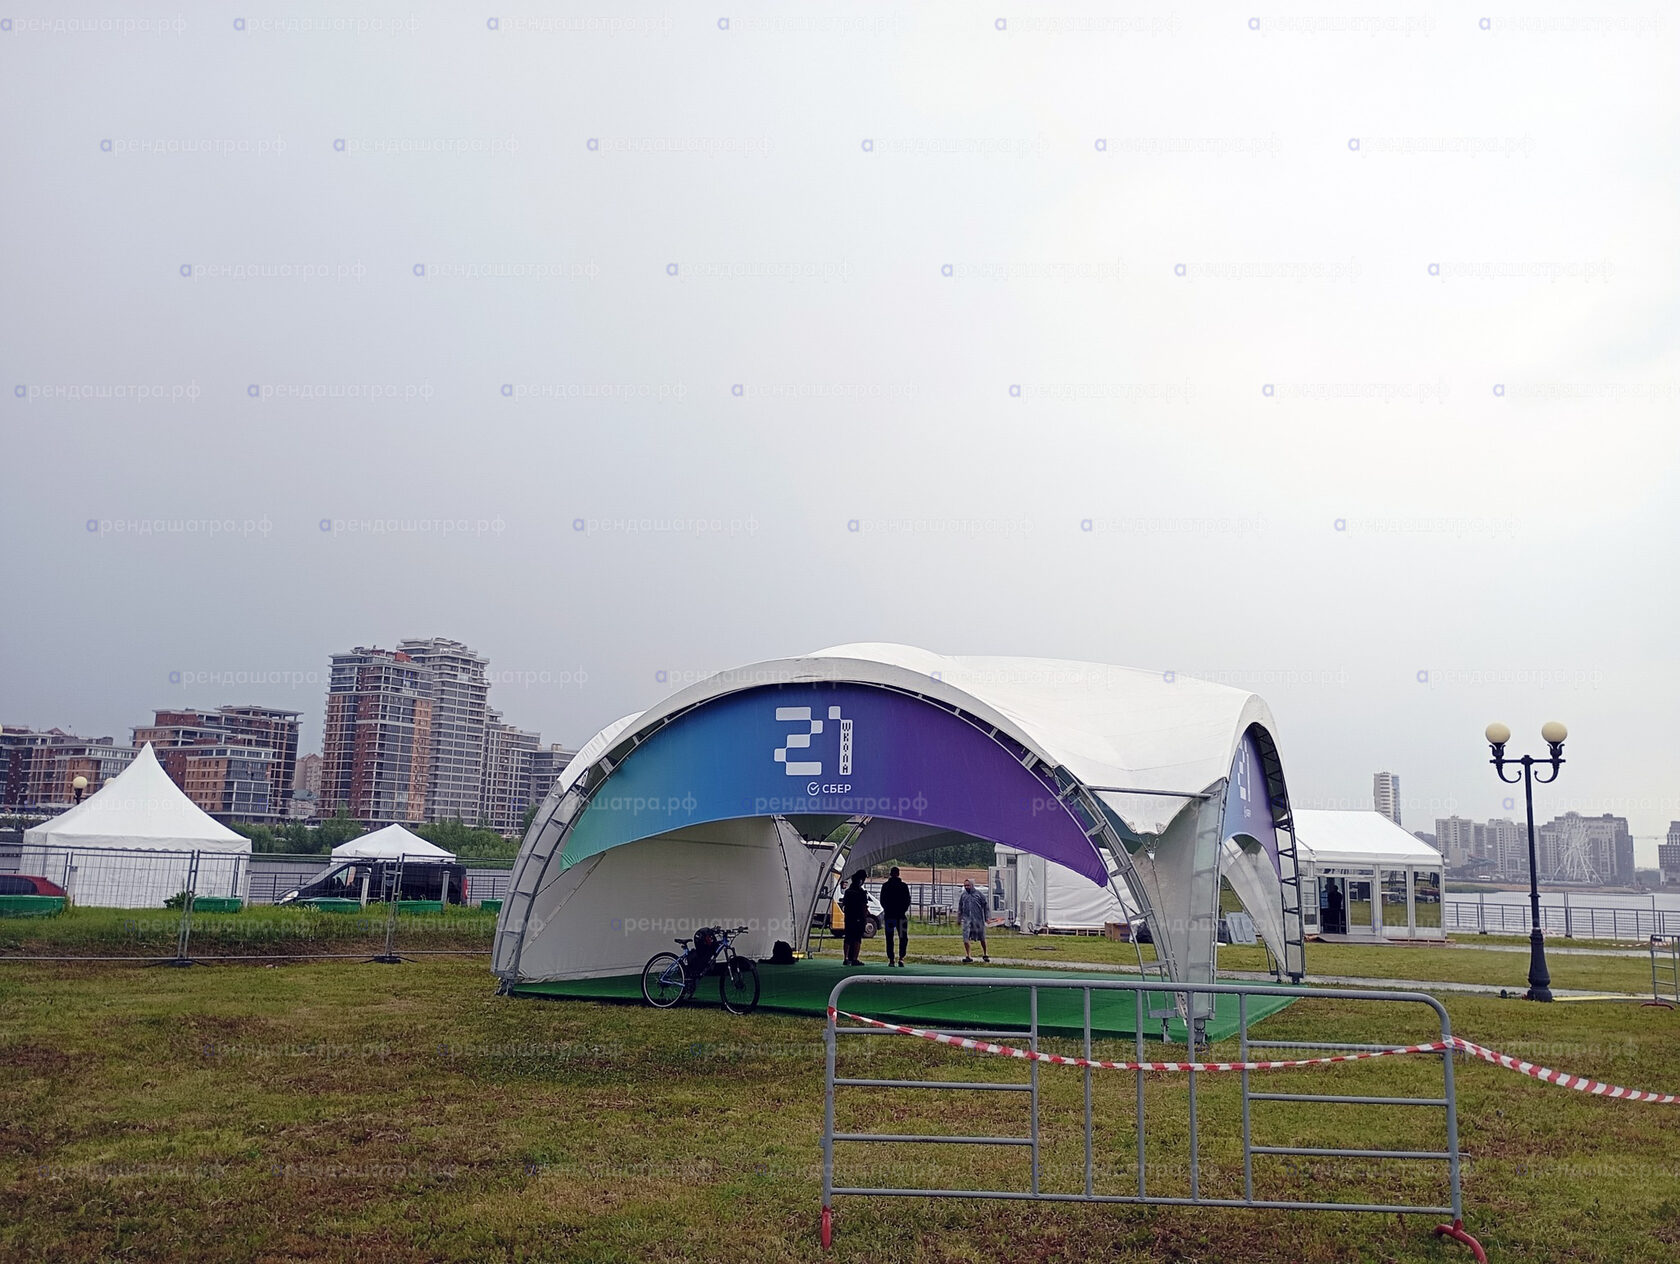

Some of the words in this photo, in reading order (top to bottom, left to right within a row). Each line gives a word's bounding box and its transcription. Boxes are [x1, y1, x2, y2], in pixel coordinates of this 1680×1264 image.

[774, 706, 853, 775] 21
[842, 722, 852, 774] ШКОЛА
[822, 784, 852, 794] СБЕР
